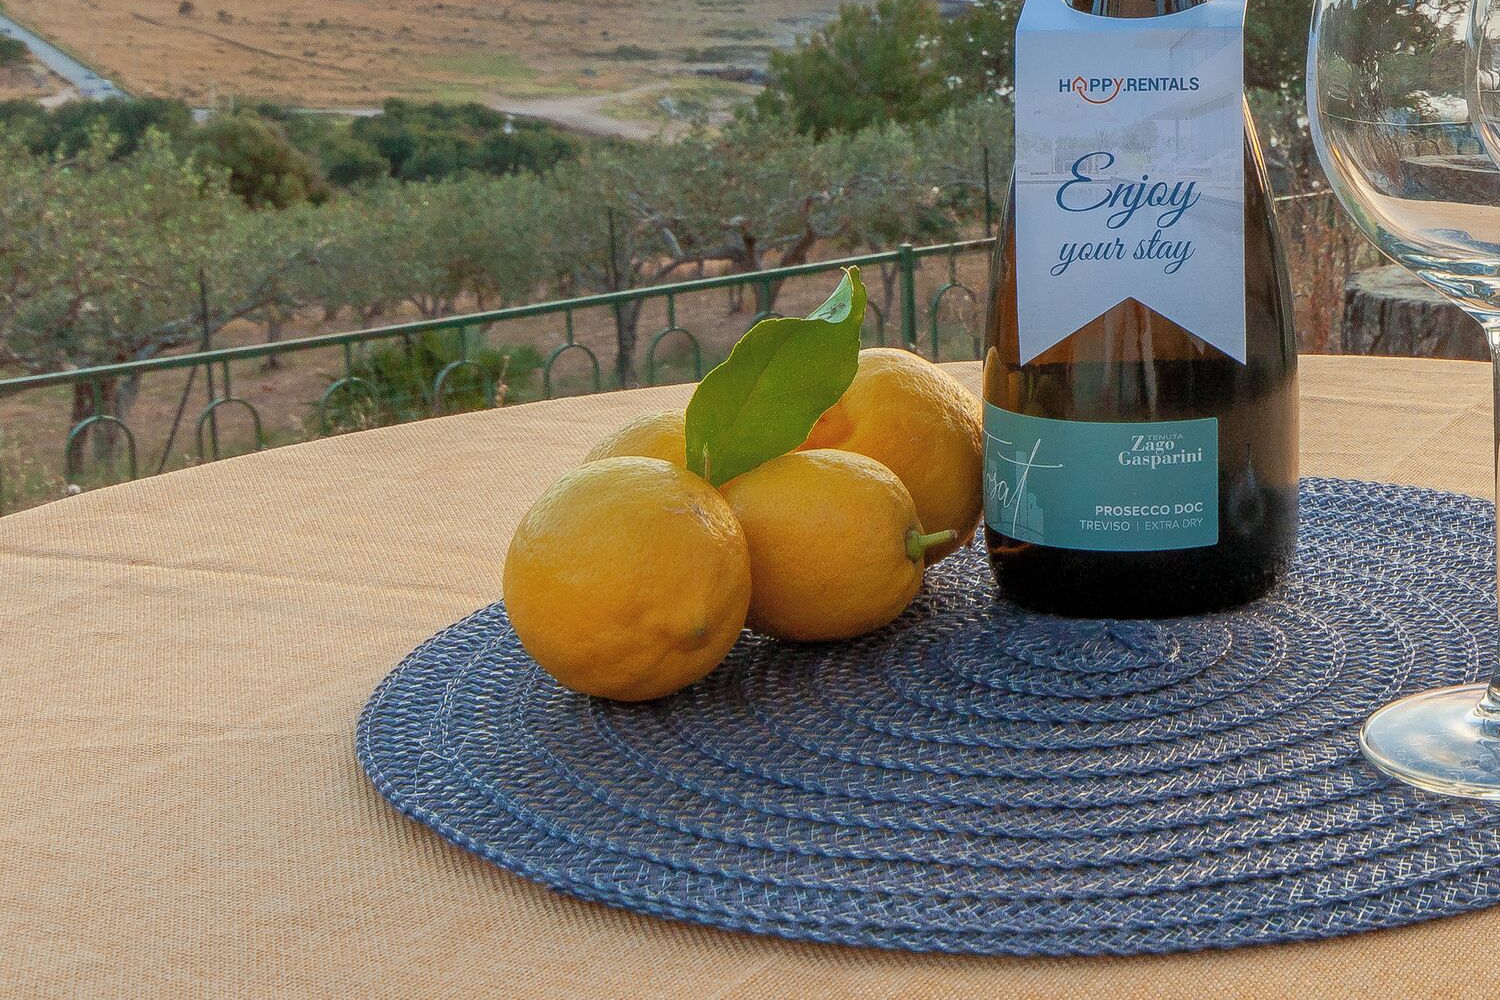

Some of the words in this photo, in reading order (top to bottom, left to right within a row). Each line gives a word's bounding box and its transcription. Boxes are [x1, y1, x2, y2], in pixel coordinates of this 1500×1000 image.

[1056, 151, 1201, 229] Enjoy
[1050, 237, 1127, 277] your
[1133, 229, 1196, 275] stay
[1131, 435, 1174, 455] Zago
[1118, 447, 1202, 470] Gasparini
[1095, 505, 1170, 516] PROSECCO
[1174, 502, 1204, 515] DOC
[1079, 519, 1131, 531] TREVISO
[1144, 520, 1180, 531] EXTRA
[1182, 516, 1204, 528] DRY
